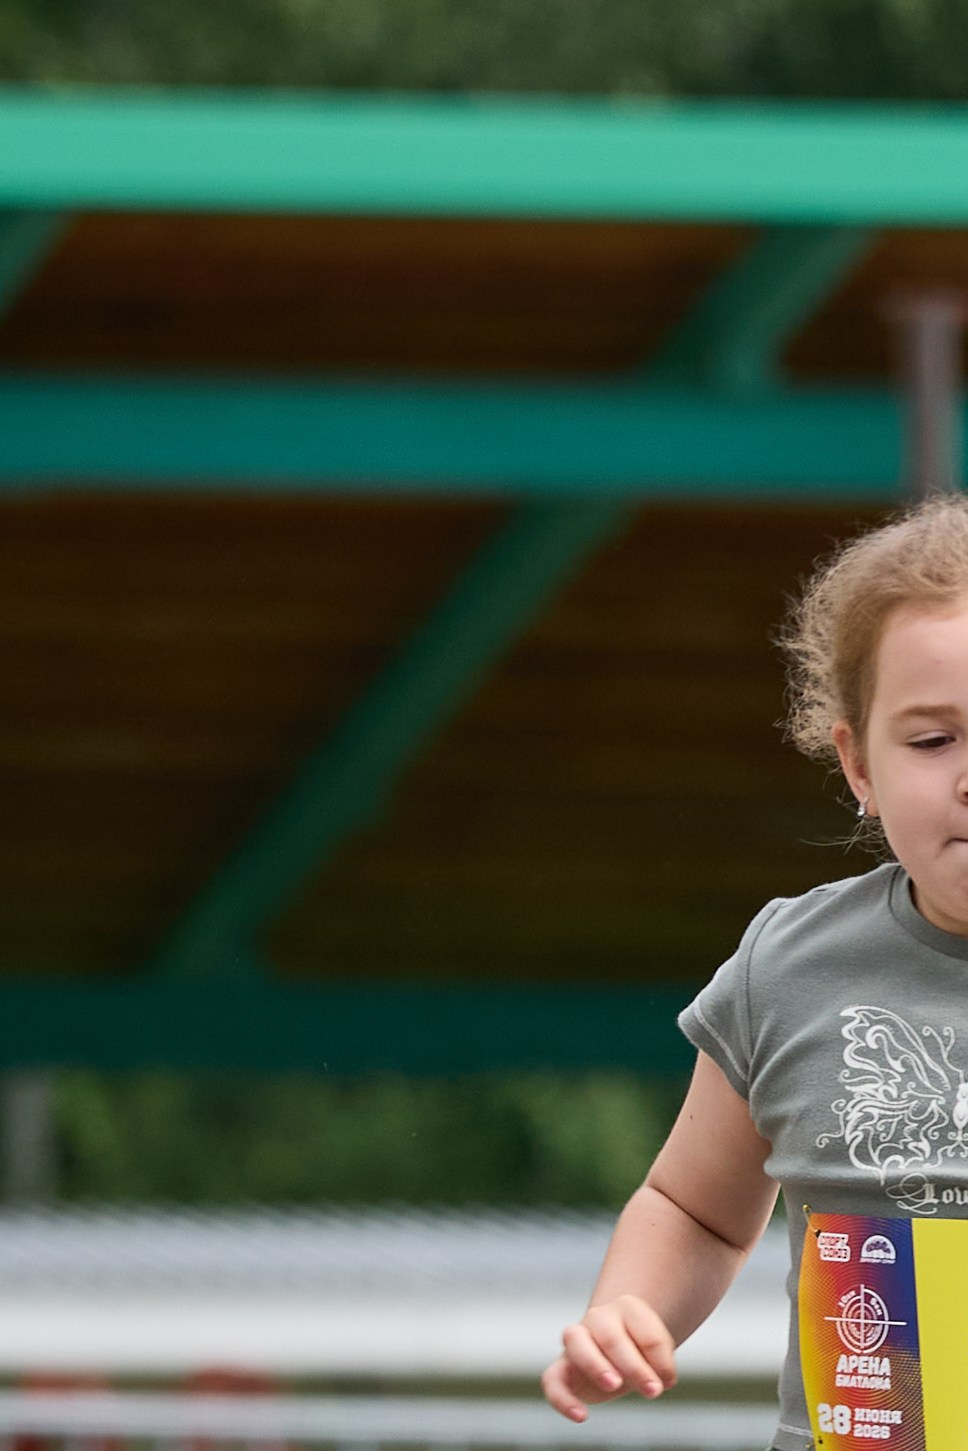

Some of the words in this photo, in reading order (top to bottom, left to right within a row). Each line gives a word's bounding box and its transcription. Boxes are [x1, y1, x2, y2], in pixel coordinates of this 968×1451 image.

[836, 1354, 891, 1376] АРЕНА
[835, 1374, 892, 1390] БИАТЛОНА
[817, 1403, 852, 1435] 28
[853, 1408, 903, 1424] ИЮНЯ
